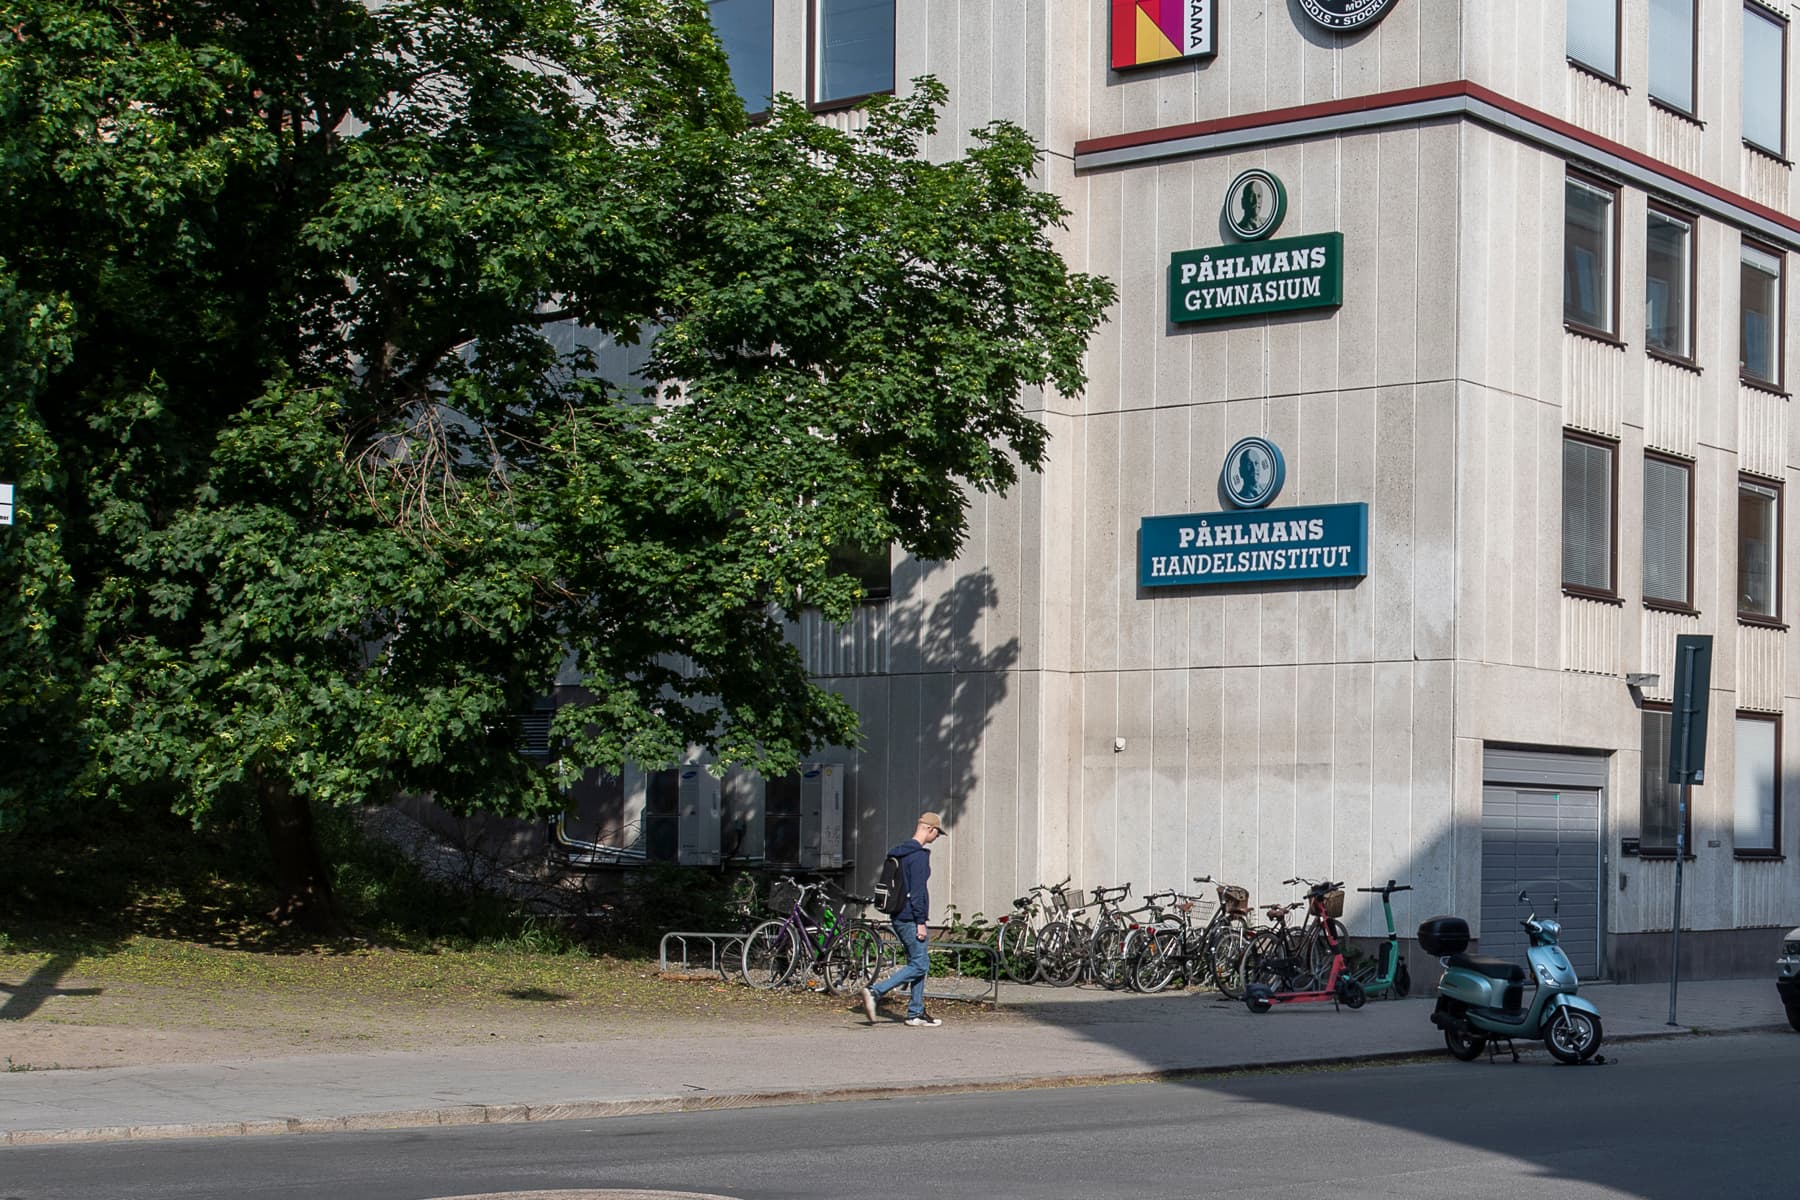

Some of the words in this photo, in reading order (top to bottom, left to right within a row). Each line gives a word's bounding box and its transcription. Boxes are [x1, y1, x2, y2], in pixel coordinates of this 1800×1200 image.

[1180, 246, 1327, 285] PÅHLMANS
[1184, 275, 1322, 312] GYMNASIUM
[1178, 518, 1325, 549] PÅHLMANS
[1151, 545, 1352, 578] HANDELSINSTITUT
